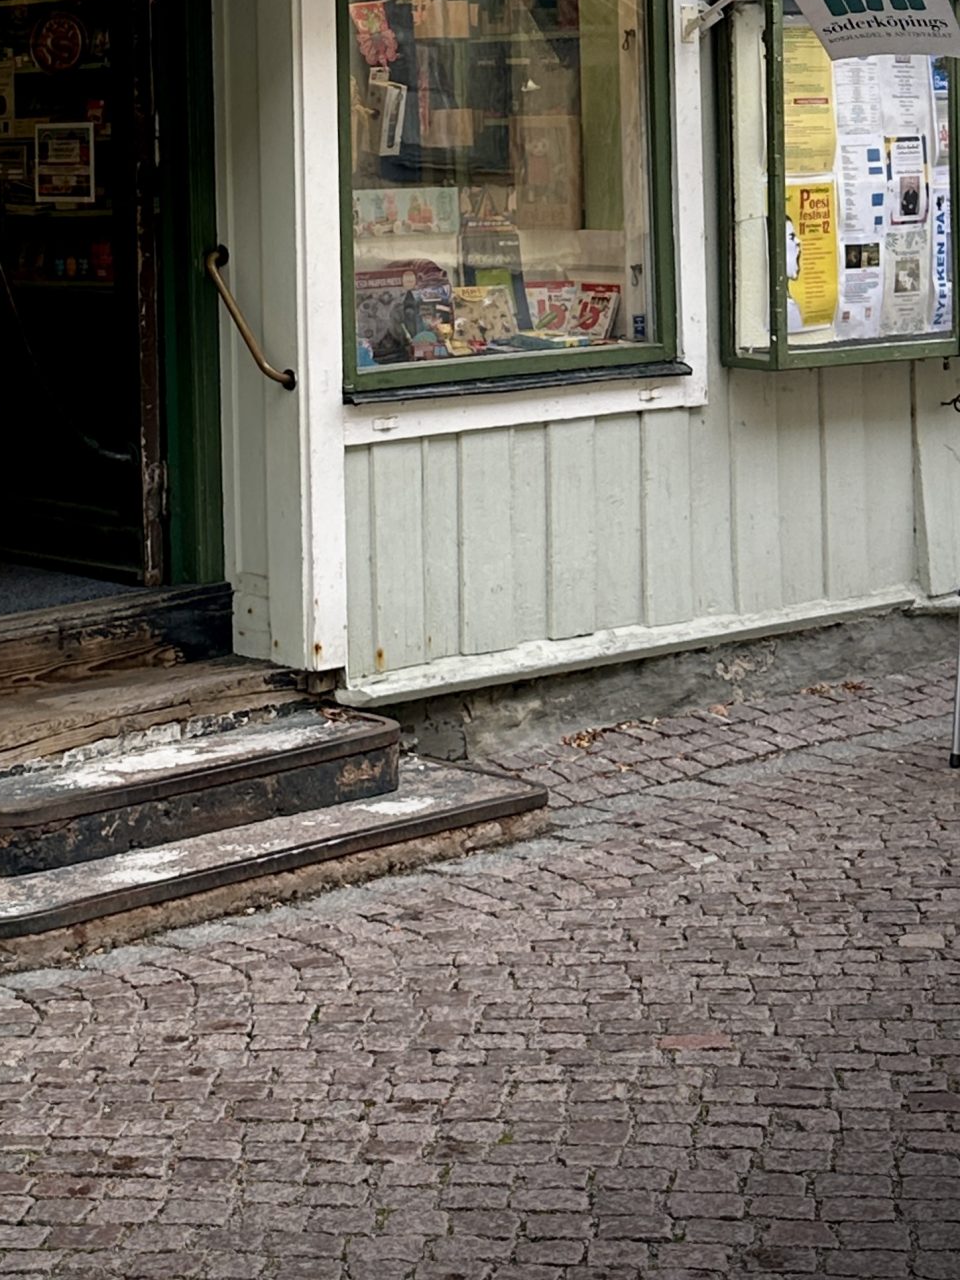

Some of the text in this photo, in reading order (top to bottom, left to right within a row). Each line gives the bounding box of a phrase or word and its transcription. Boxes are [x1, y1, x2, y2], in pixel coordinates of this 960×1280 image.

[822, 14, 949, 36] söderköpings
[799, 188, 830, 211] Poesi
[800, 208, 831, 222] festival
[933, 241, 947, 326] NYFIKEN
